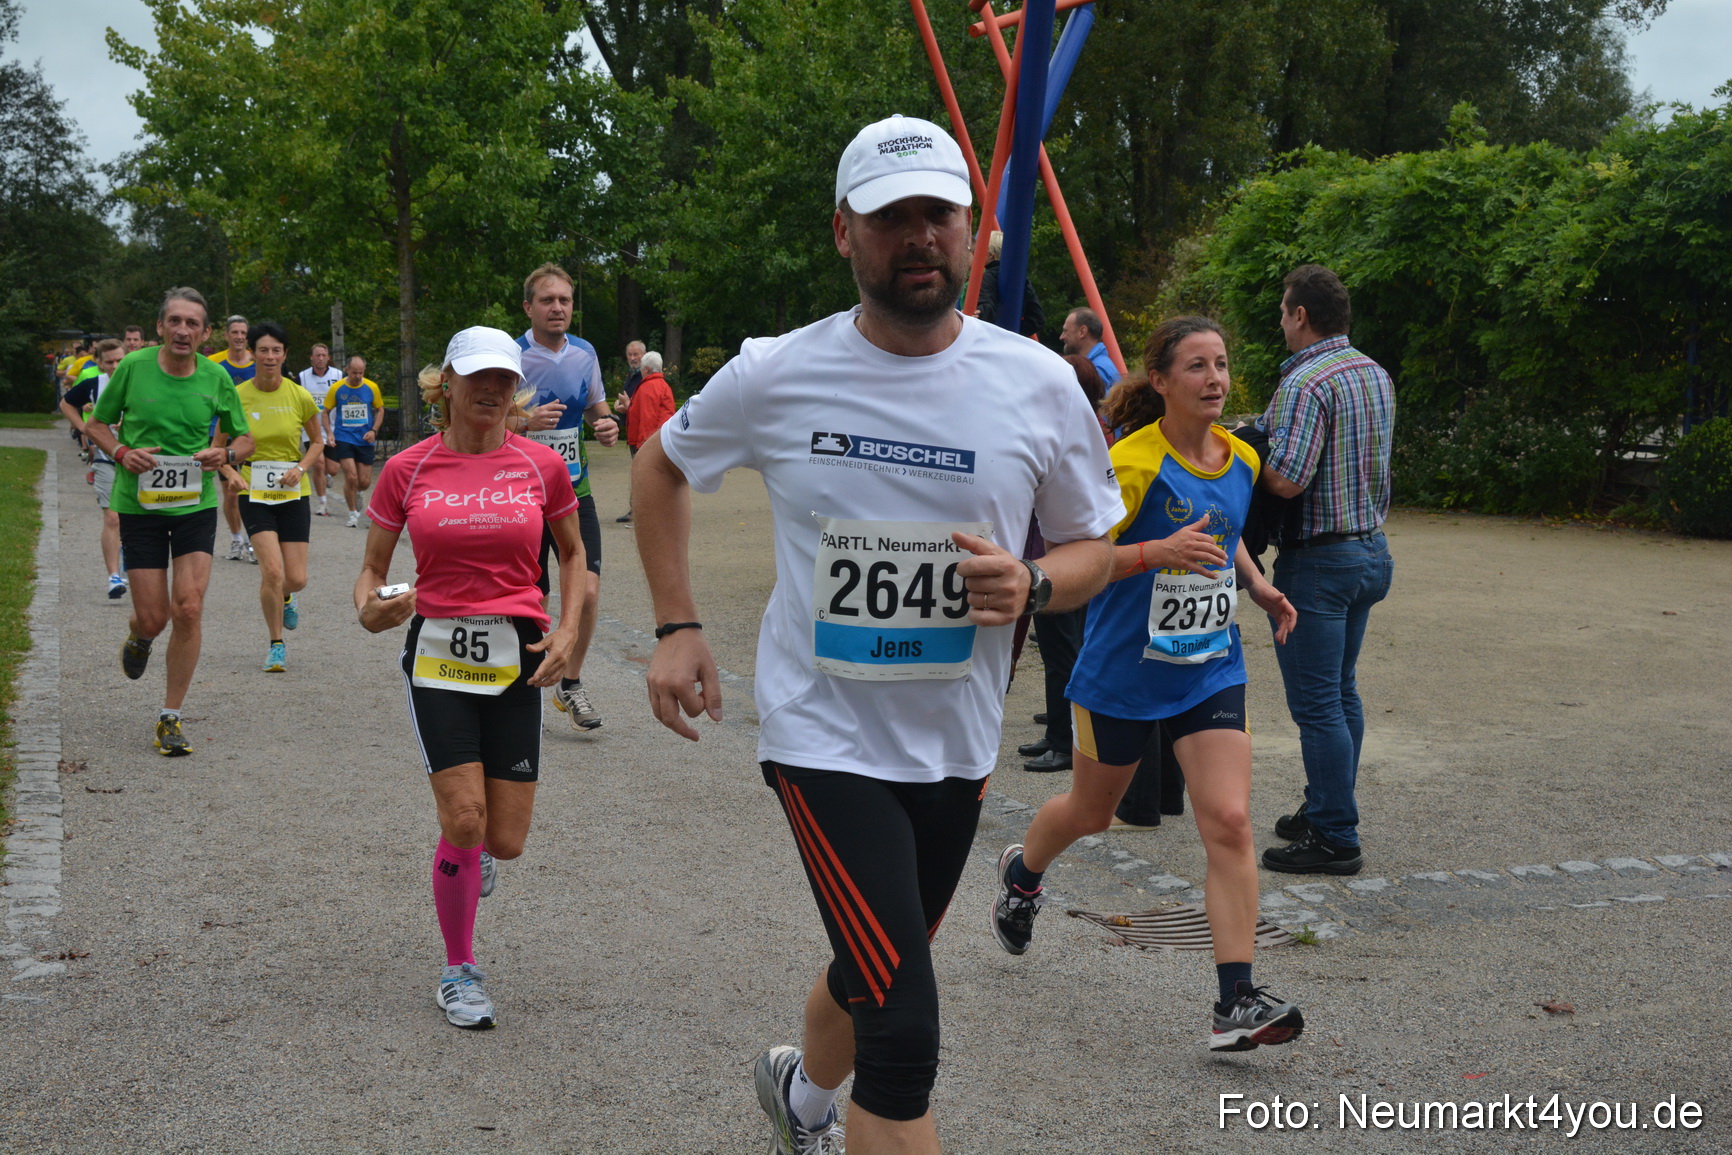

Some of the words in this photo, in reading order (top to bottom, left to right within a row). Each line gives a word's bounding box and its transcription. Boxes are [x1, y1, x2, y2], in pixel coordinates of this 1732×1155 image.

[878, 136, 932, 149] STOCKHOLM
[880, 143, 932, 155] MARATHON
[897, 150, 918, 158] 2010
[344, 409, 365, 419] 3424
[859, 440, 968, 469] BÜSCHEL
[151, 469, 188, 488] 281
[505, 471, 529, 479] asics
[809, 457, 900, 475] FEINSCHNEIDTECHNIK
[909, 469, 975, 485] WERKZEUGBAU
[263, 492, 287, 501] Brigitte
[421, 485, 537, 509] Perfekt
[821, 532, 873, 551] PARTL
[829, 559, 970, 619] 2649
[1155, 583, 1187, 593] PARTL
[1188, 580, 1223, 592] Neumarkt
[457, 616, 503, 626] Neumarkt
[1158, 593, 1230, 630] 2379
[449, 626, 490, 663] 85
[870, 635, 923, 658] Jens
[1172, 638, 1210, 654] Daniela
[438, 663, 497, 682] Susanne
